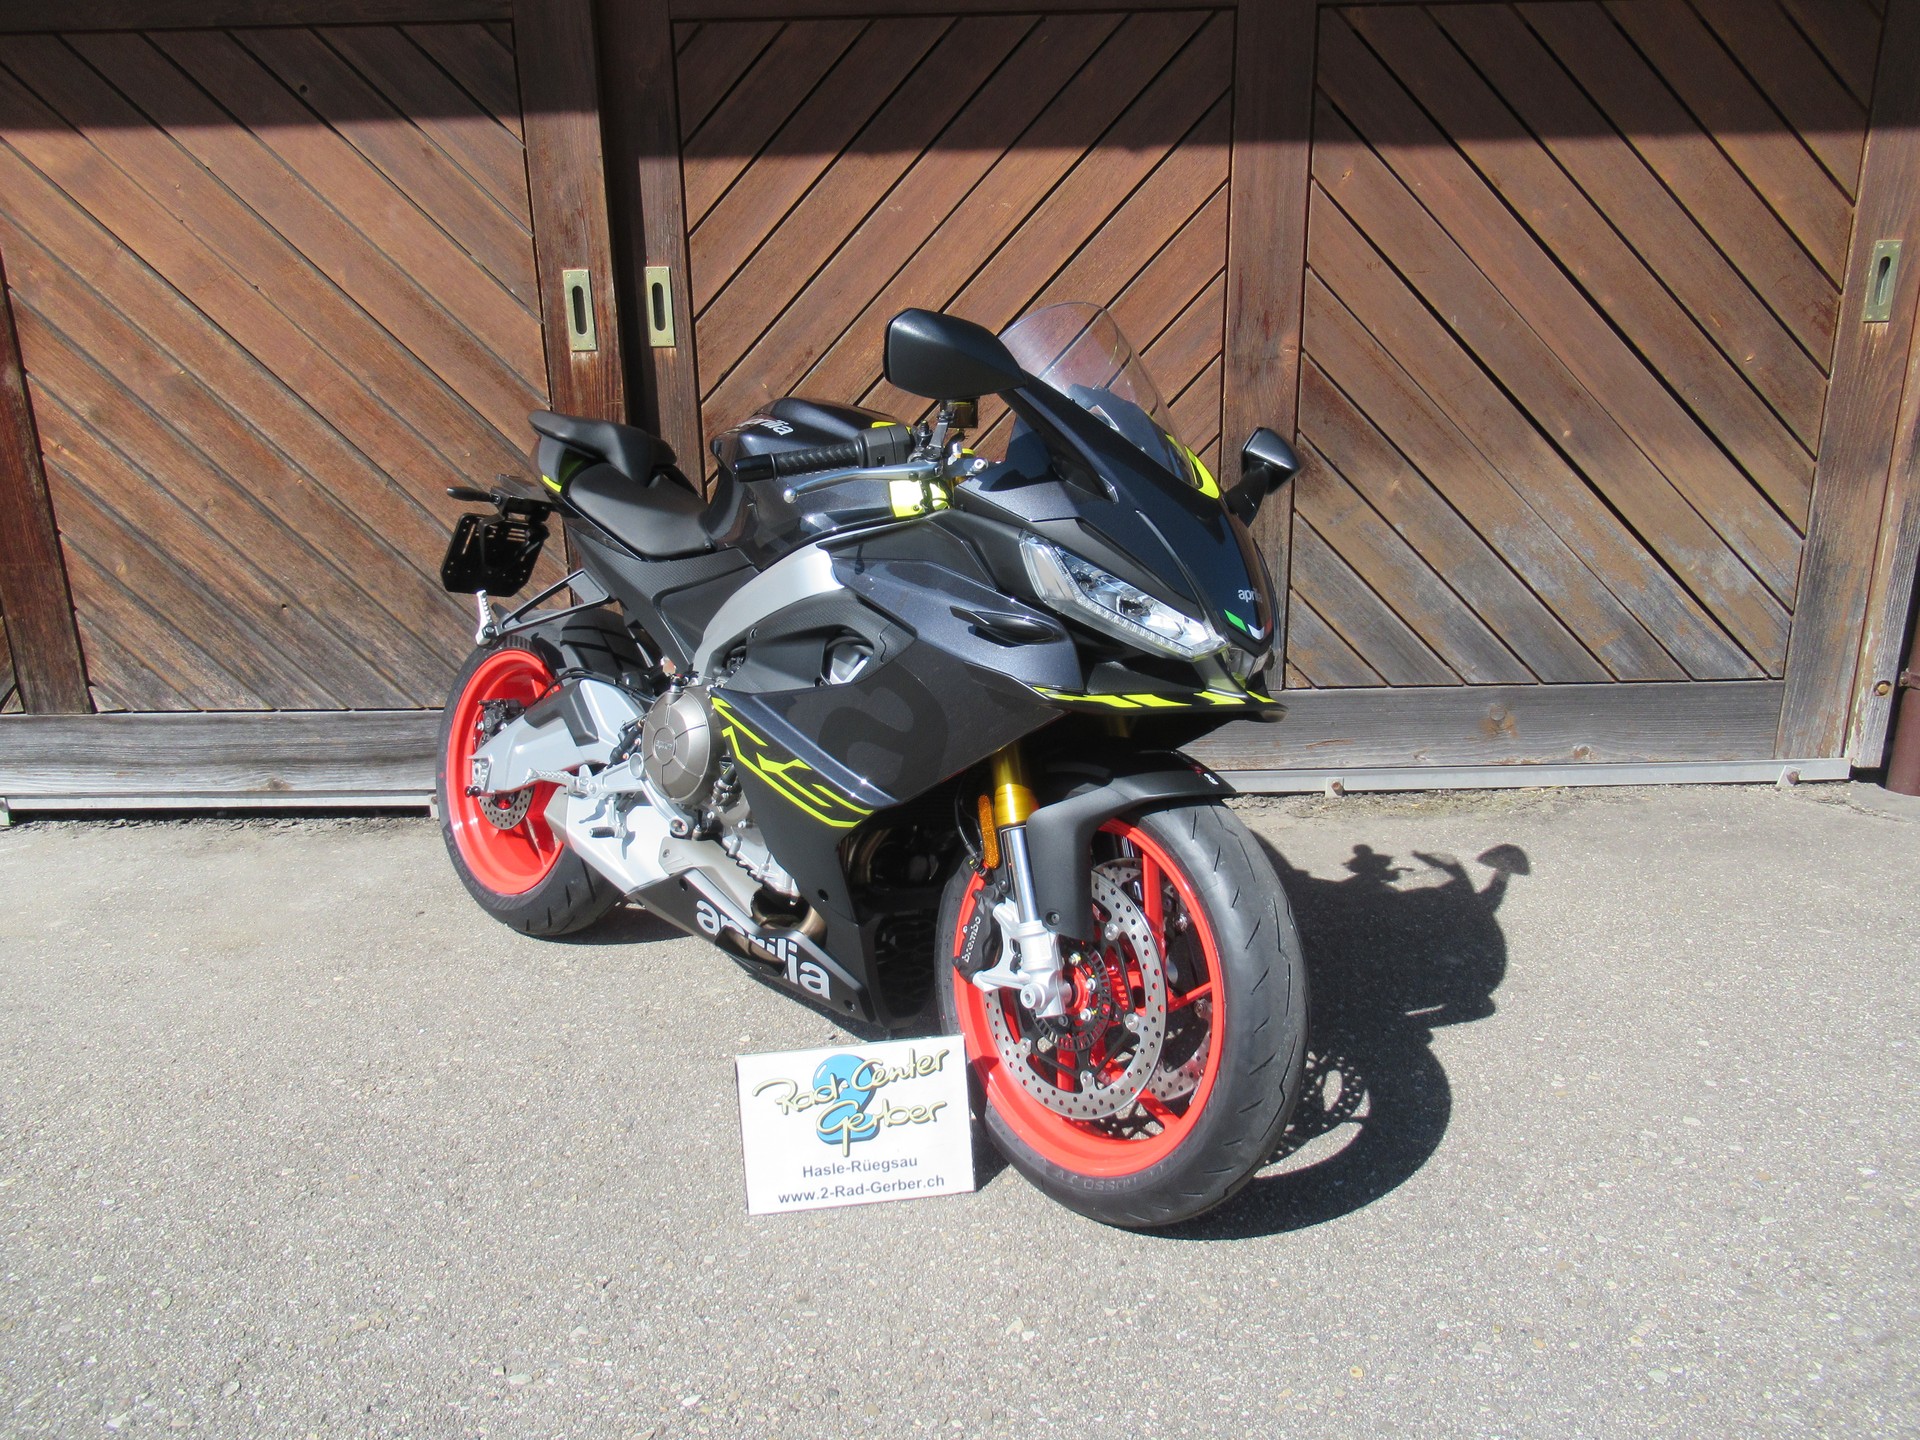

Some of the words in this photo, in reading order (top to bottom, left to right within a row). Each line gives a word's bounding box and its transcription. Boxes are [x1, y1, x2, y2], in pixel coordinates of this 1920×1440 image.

[961, 915, 982, 964] brembo
[816, 1099, 948, 1157] Gerber
[802, 1157, 918, 1178] Hasle-Rüegsau
[778, 1174, 945, 1204] www.2-Rad-Gerber.ch
